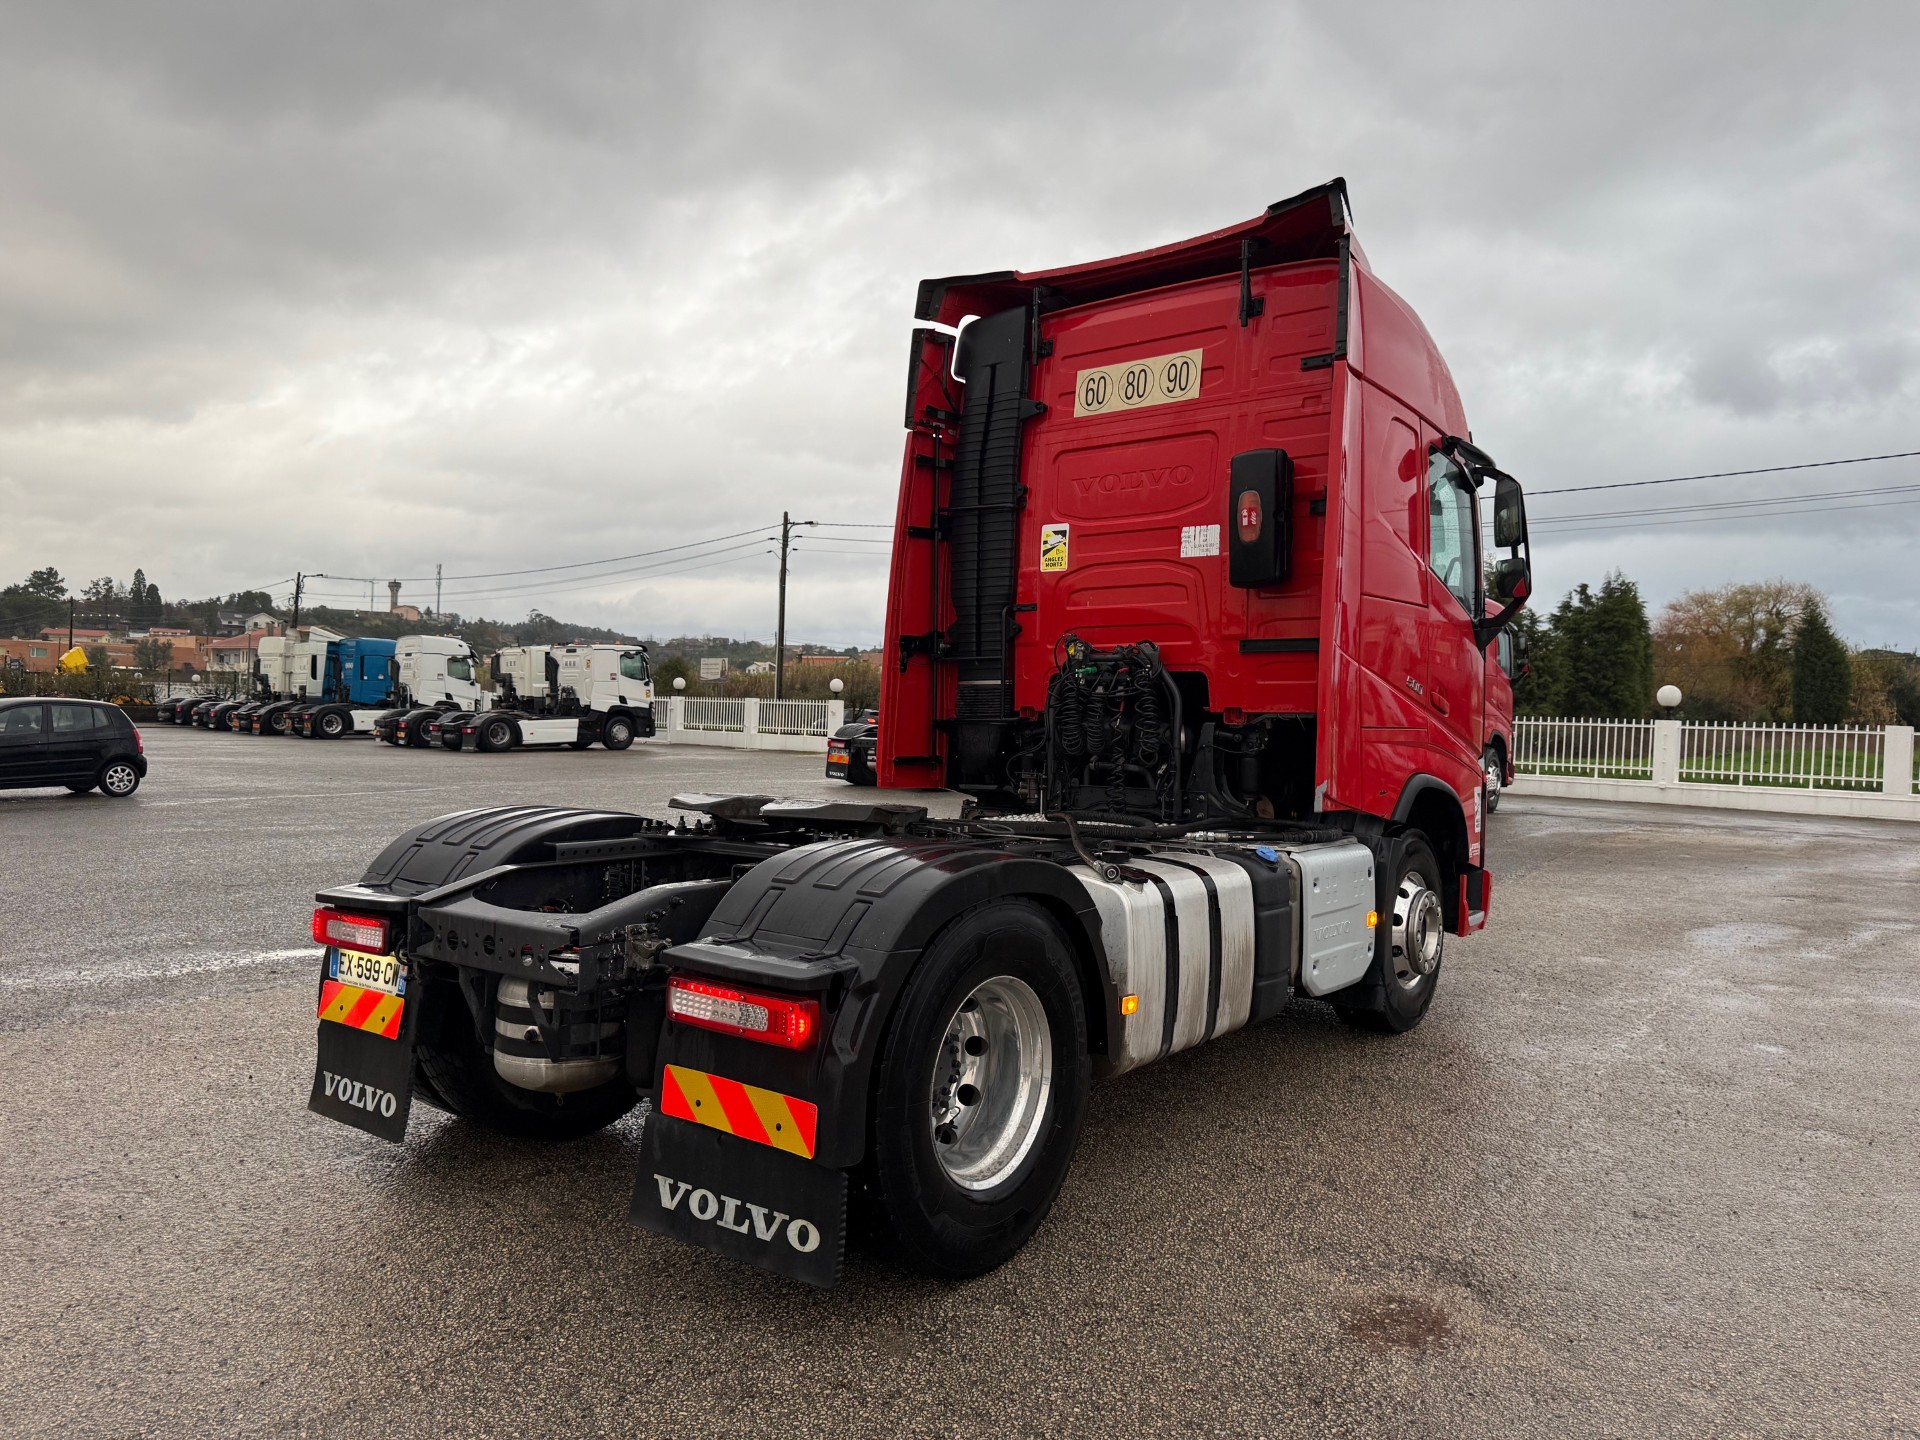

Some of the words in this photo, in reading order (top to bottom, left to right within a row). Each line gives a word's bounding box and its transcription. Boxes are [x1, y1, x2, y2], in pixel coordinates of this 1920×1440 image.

[1085, 376, 1107, 407] 60
[1124, 368, 1148, 400] 80
[1167, 361, 1190, 393] 90
[1072, 464, 1194, 497] VOLVO
[1313, 920, 1351, 942] VOLVO
[323, 1070, 397, 1118] VOLVO
[653, 1173, 821, 1253] VOLVO
